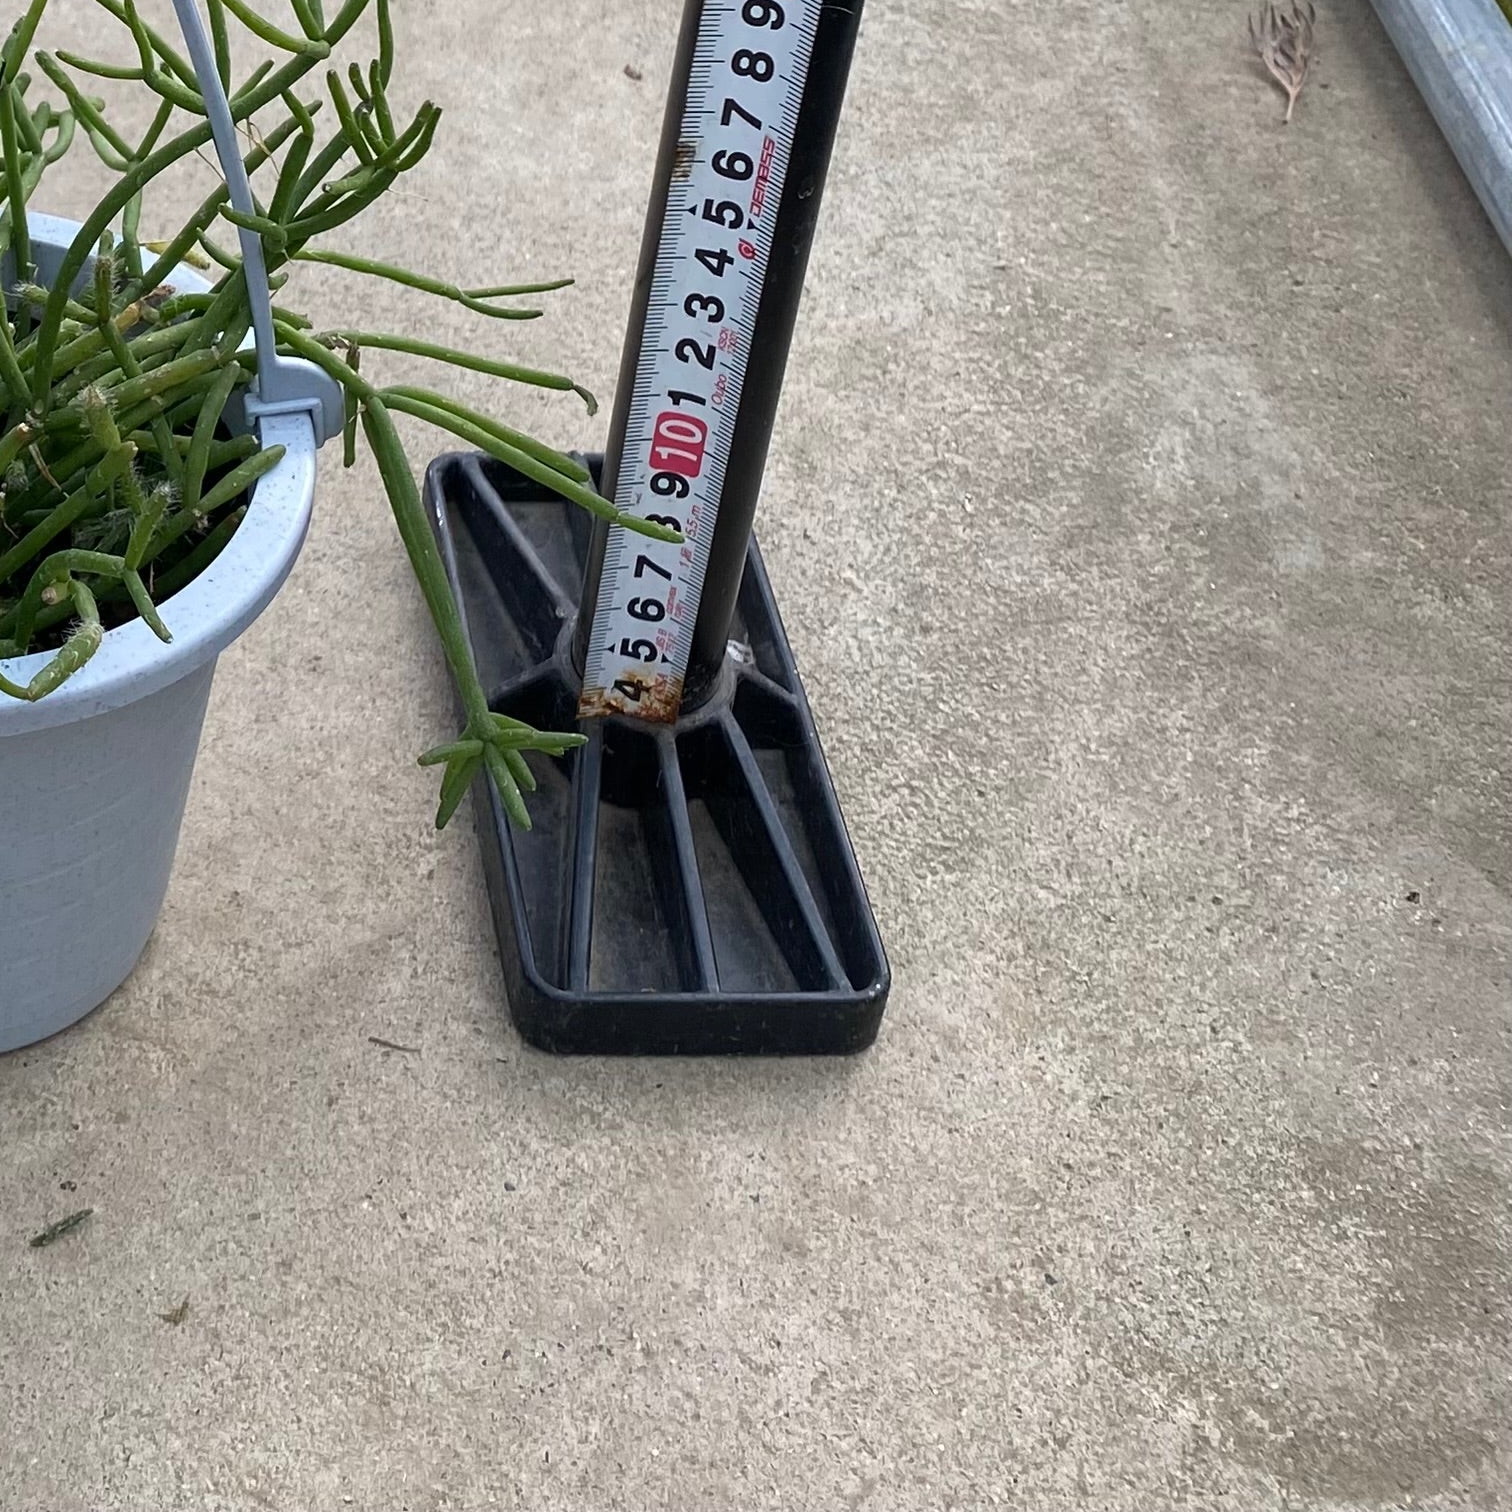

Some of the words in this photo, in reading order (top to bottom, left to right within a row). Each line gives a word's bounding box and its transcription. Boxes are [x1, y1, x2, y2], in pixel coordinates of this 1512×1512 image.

[731, 49, 774, 83] 8
[720, 98, 762, 130] 7
[711, 150, 754, 181] 6
[702, 198, 744, 229] 5
[694, 248, 735, 277] 4
[684, 292, 725, 323] 3
[675, 338, 716, 370] 2
[668, 390, 706, 406] 1
[655, 419, 702, 461] 10
[650, 471, 690, 499] 9
[634, 555, 672, 581] 7
[627, 597, 665, 622] 6
[620, 638, 657, 662] 5
[613, 679, 649, 702] 4
